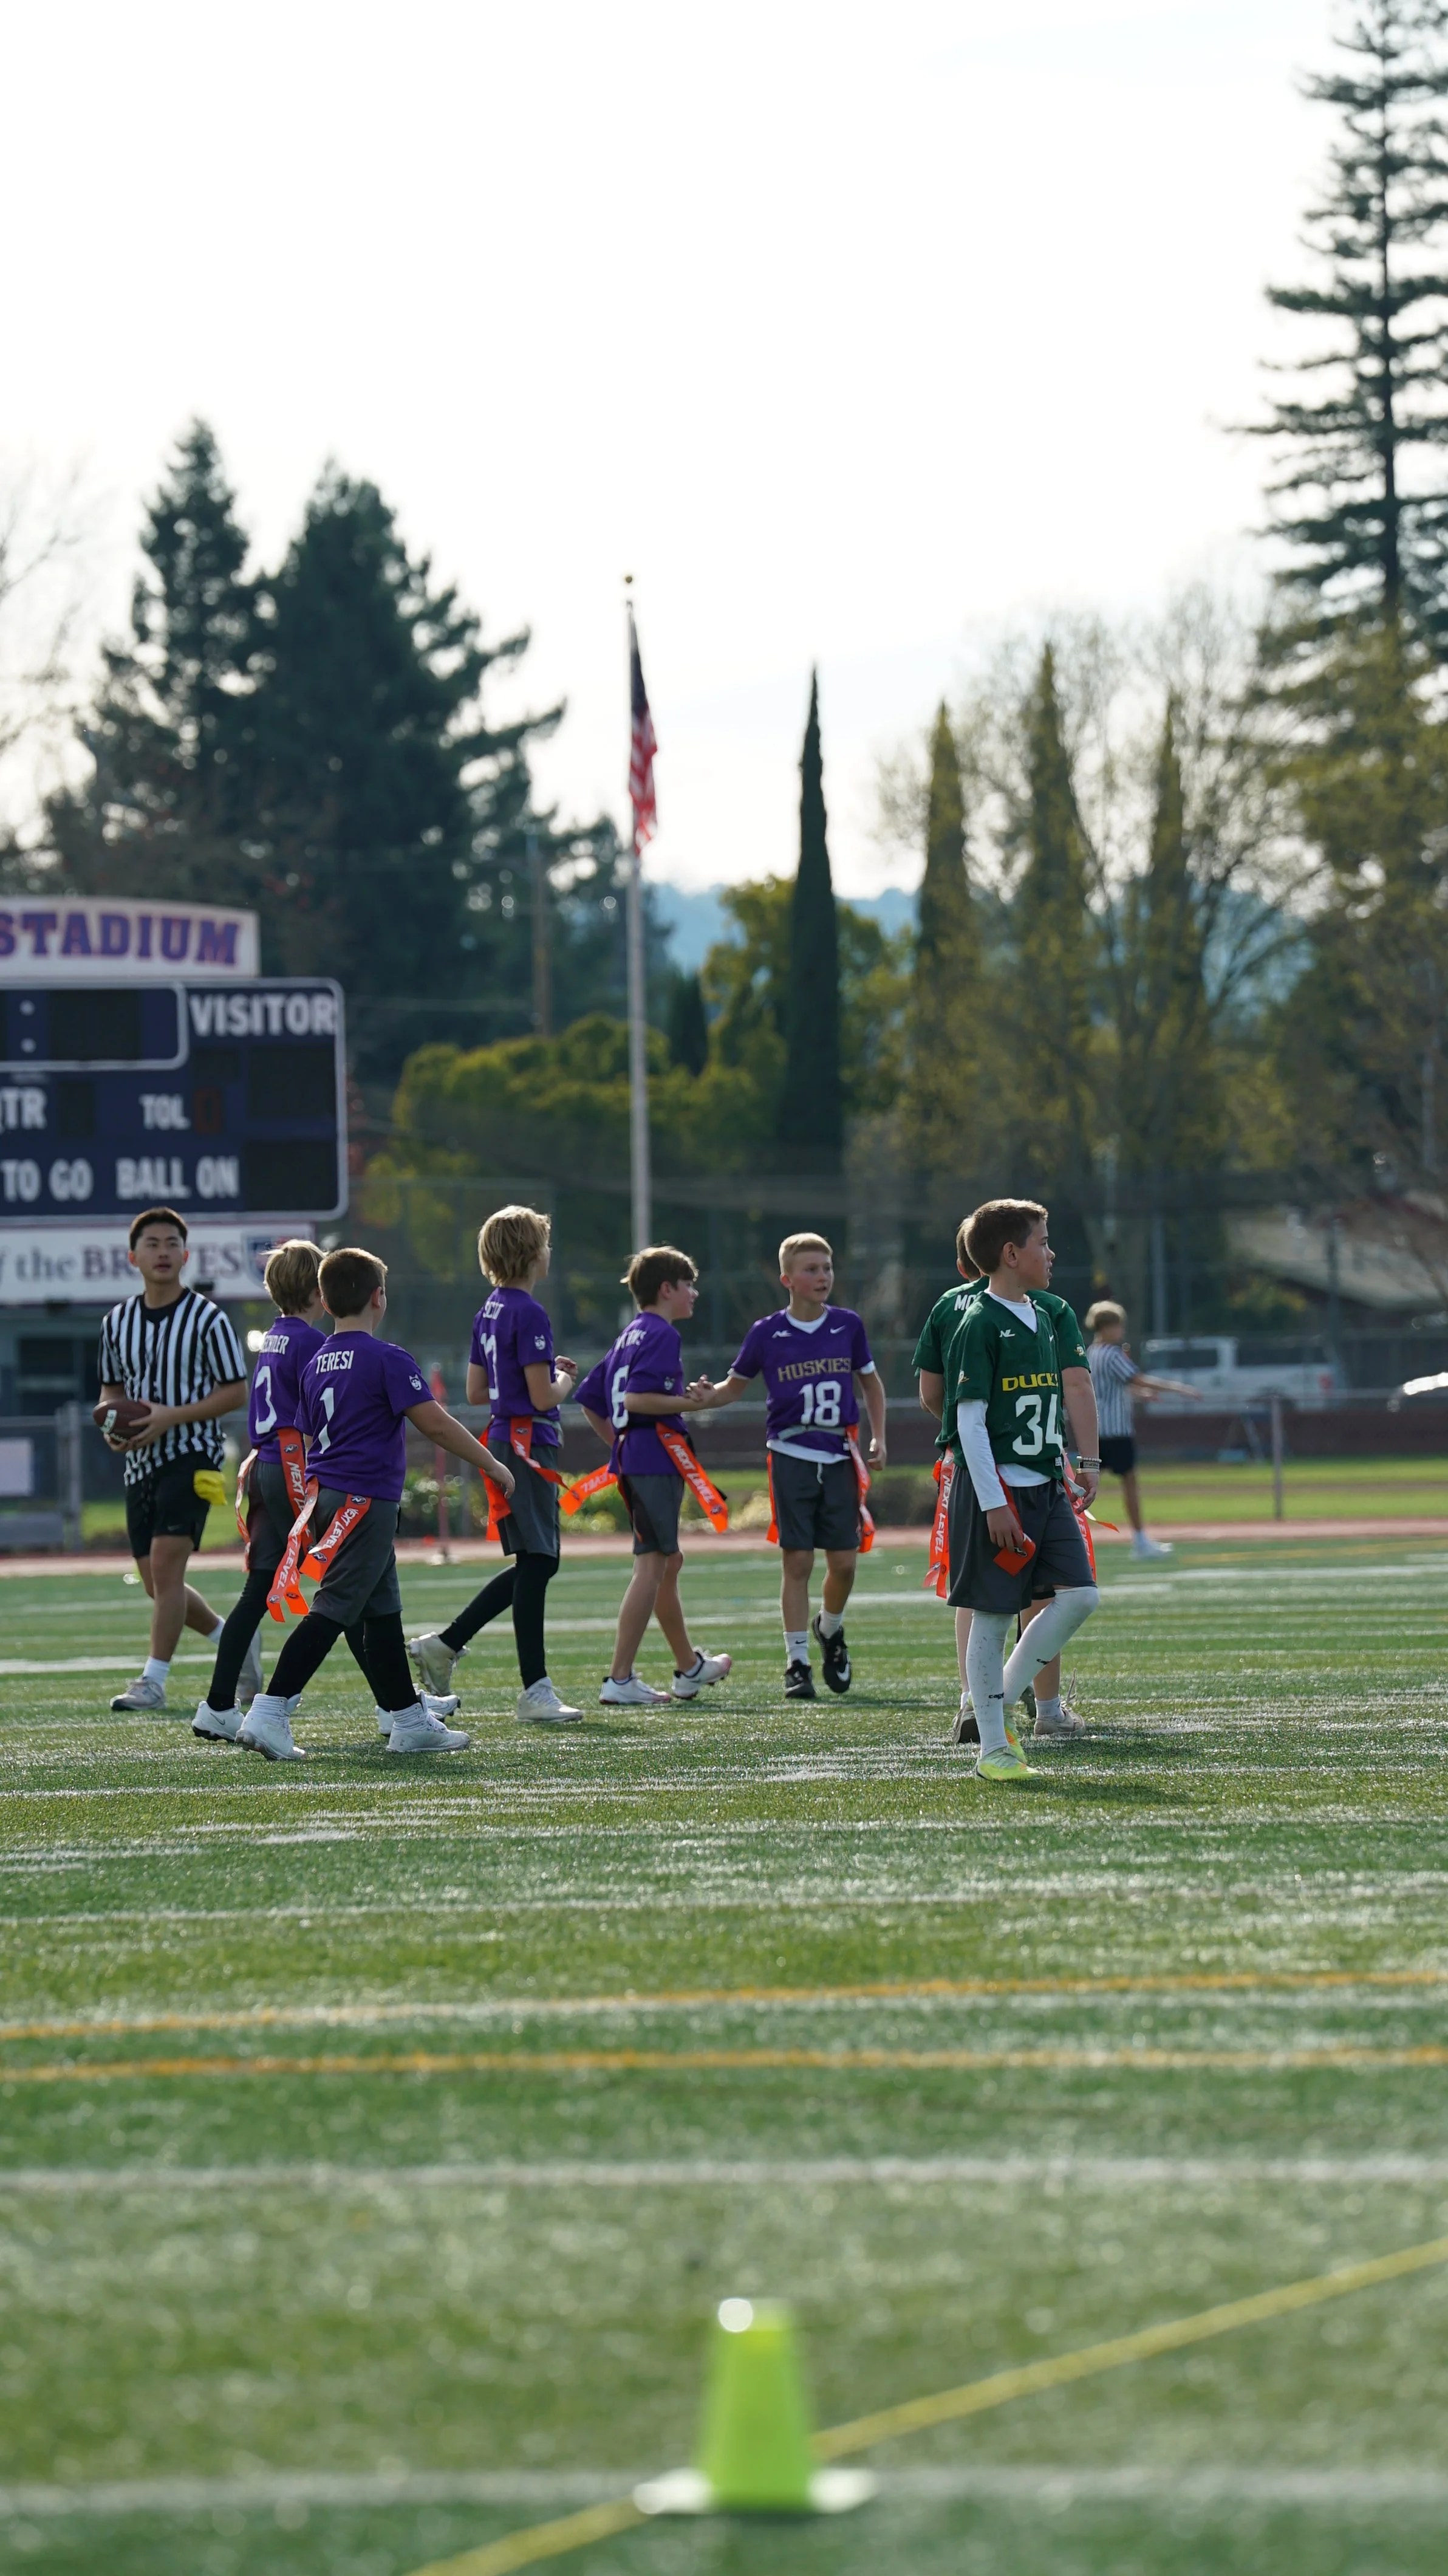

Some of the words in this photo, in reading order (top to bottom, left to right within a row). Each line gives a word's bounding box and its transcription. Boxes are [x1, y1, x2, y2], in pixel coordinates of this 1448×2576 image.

[191, 995, 338, 1035] VISITOR
[0, 1086, 47, 1133] TR
[139, 1094, 190, 1129] TOL
[1, 1158, 41, 1202] TO
[49, 1158, 94, 1201] GO
[115, 1157, 191, 1199] BALL
[196, 1156, 239, 1199] ON
[15, 1245, 79, 1282] the
[82, 1243, 244, 1282] BRES
[315, 1350, 354, 1374] TERESI
[777, 1357, 851, 1382] HUSKIES
[254, 1366, 278, 1434] 3
[318, 1387, 335, 1454] 1
[799, 1380, 841, 1427] 18
[1013, 1394, 1063, 1456] 34
[286, 1461, 305, 1496] NEXT
[669, 1444, 697, 1470] NEXT
[941, 1475, 952, 1510] NEXT
[935, 1512, 946, 1555] LEVEL
[277, 1547, 296, 1590] LEVEL
